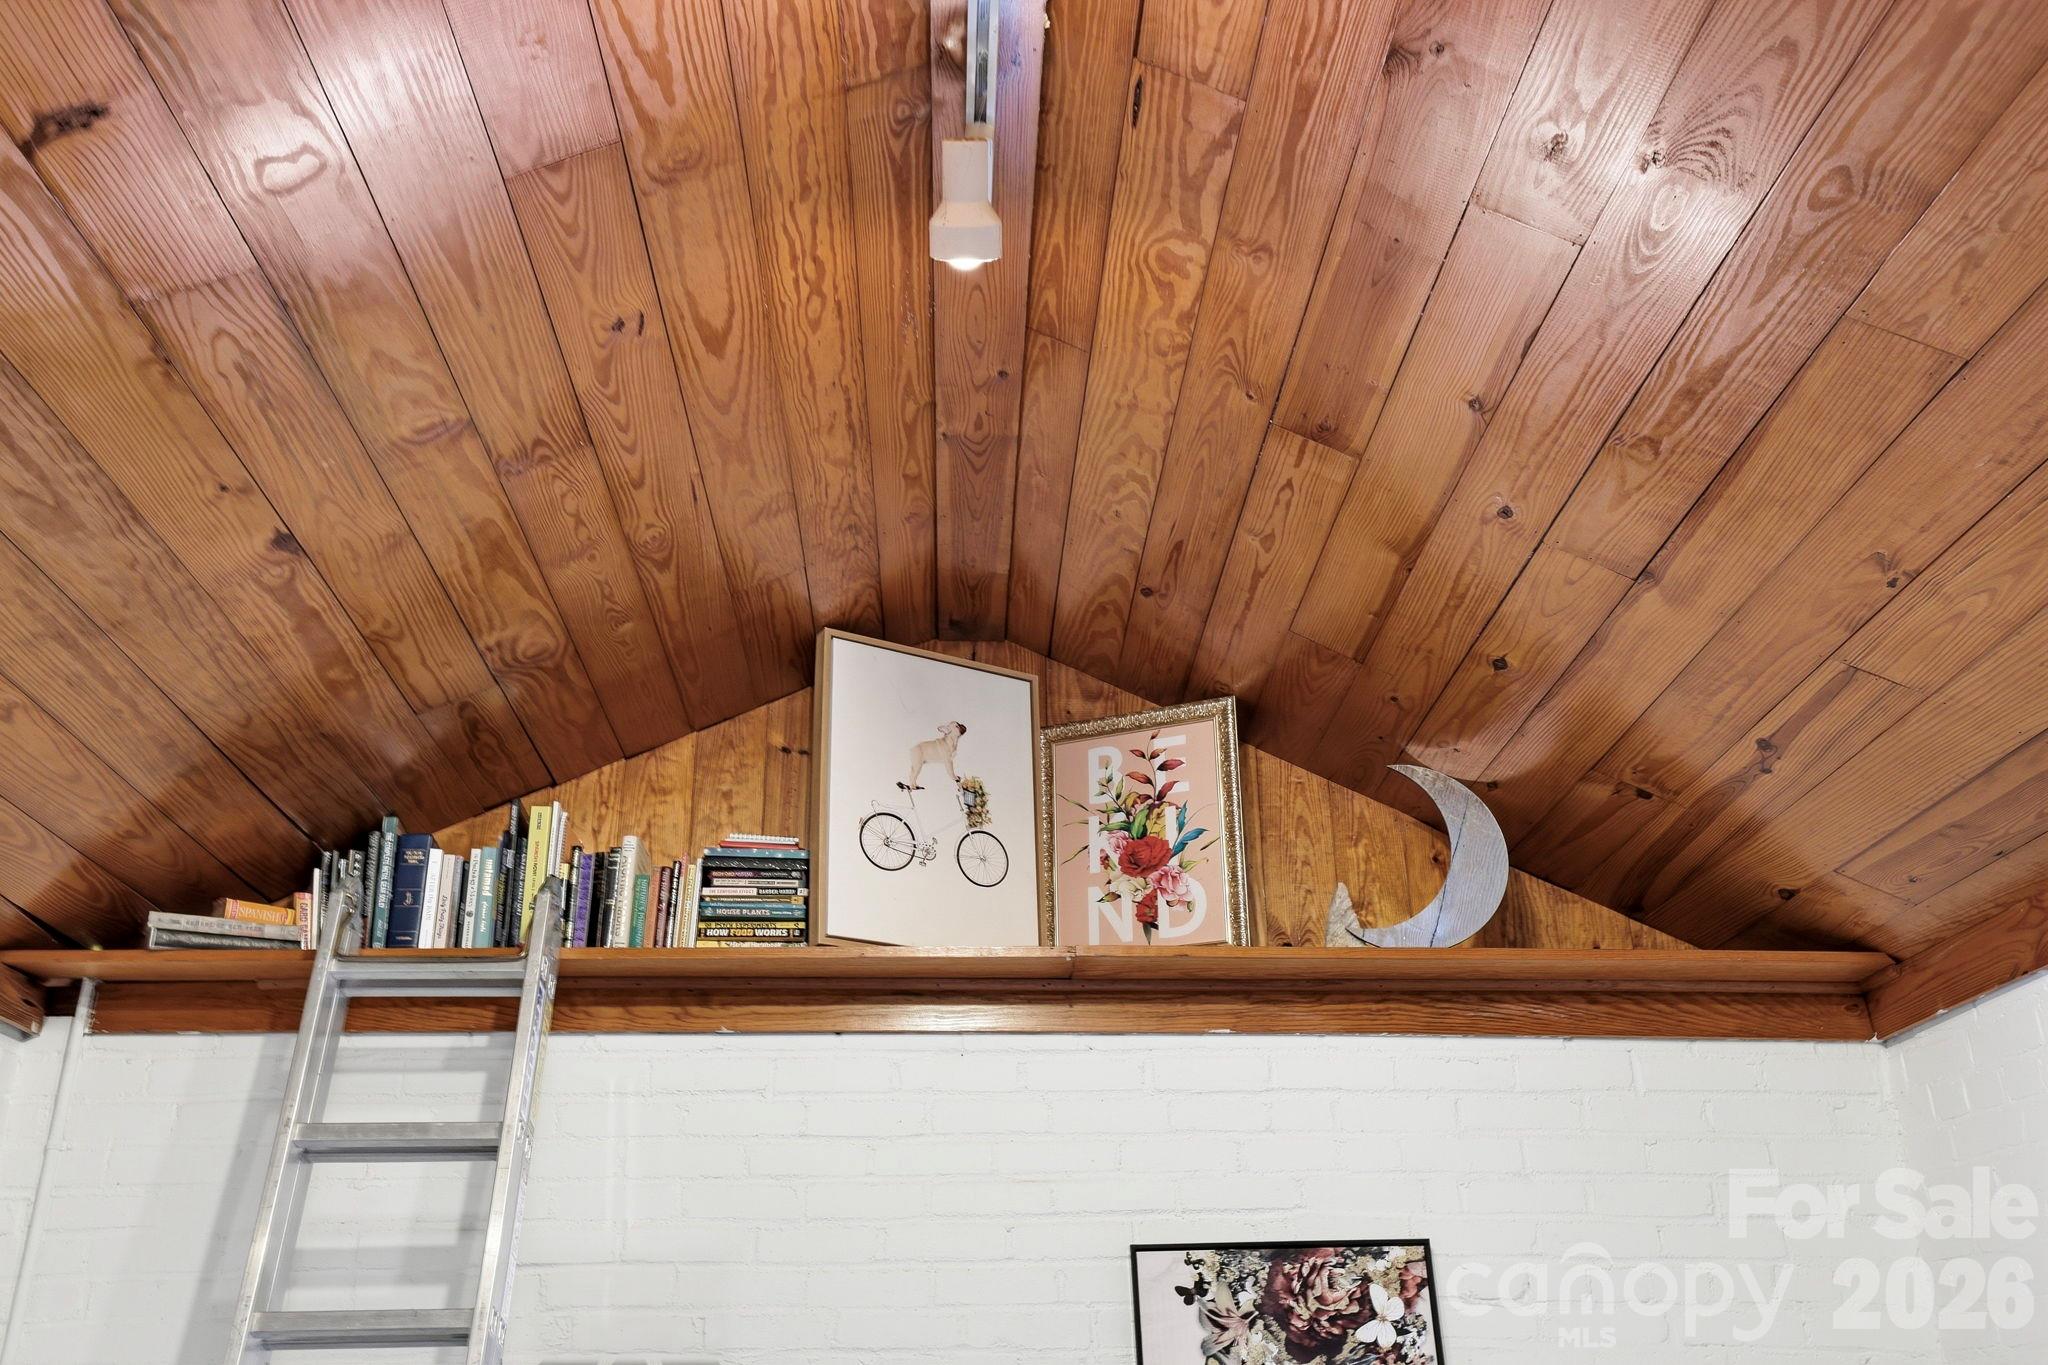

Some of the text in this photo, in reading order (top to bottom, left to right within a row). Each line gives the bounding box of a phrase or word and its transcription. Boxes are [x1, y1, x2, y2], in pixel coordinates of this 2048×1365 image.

[481, 858, 494, 896] untamed
[706, 929, 788, 937] HOW FOOD WORKS
